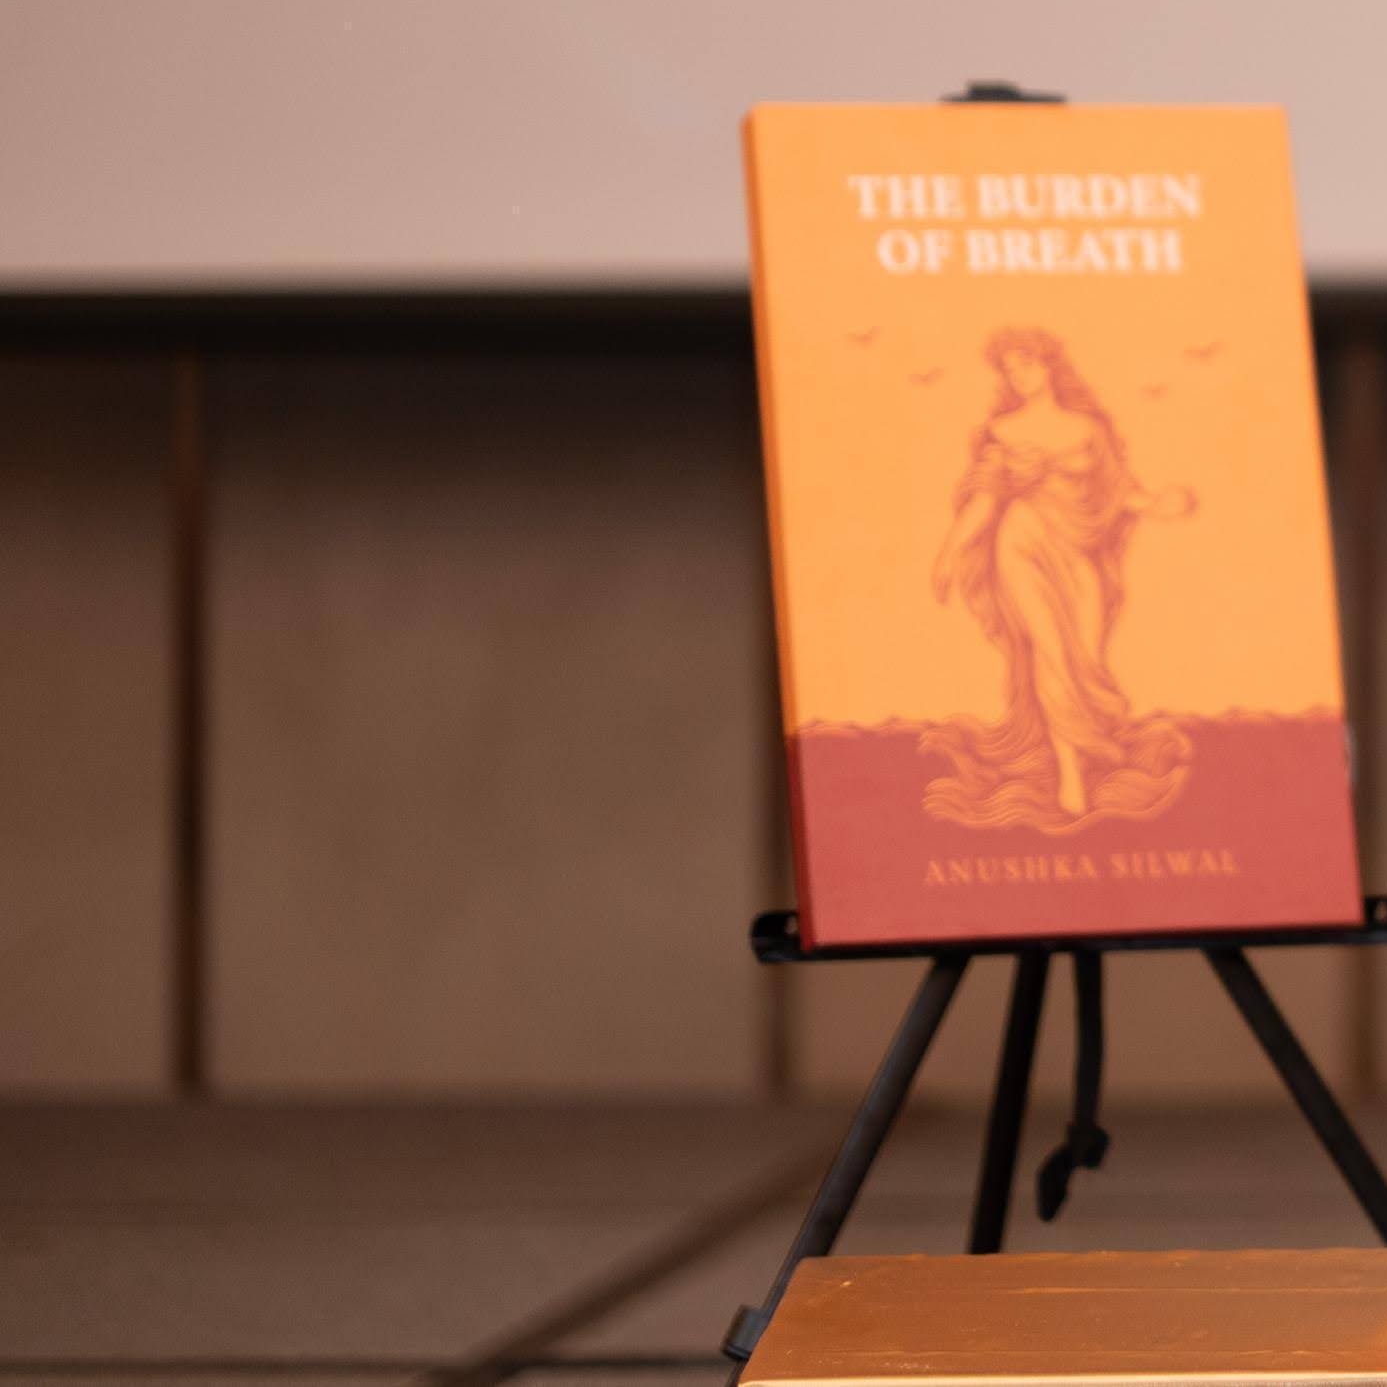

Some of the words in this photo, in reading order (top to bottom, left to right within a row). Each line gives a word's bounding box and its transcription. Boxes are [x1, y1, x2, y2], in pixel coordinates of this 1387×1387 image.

[849, 173, 966, 219] THE
[974, 172, 1204, 219] BURDEN
[875, 227, 956, 276] OF
[963, 226, 1184, 275] BREATH
[923, 853, 1099, 886] ANUSHKA
[1108, 849, 1241, 879] SILWAL
